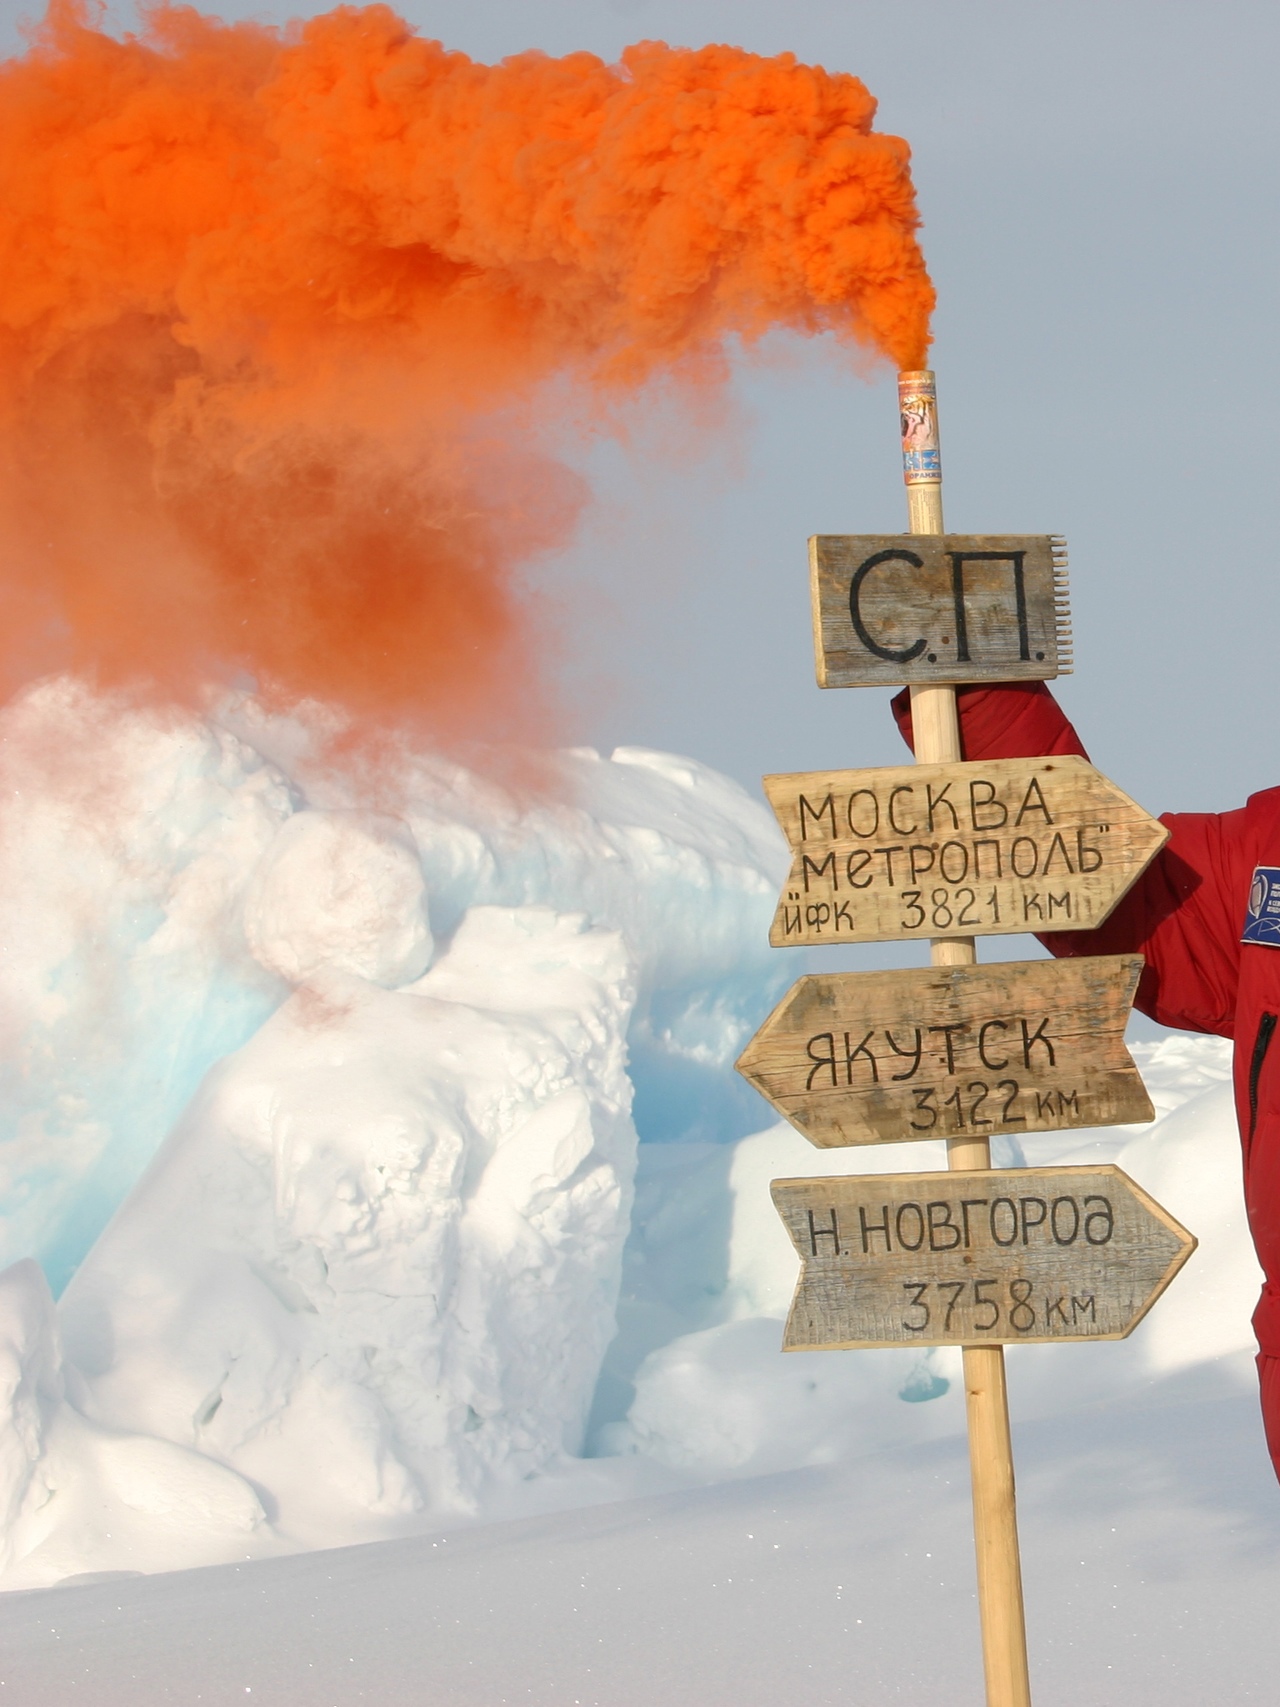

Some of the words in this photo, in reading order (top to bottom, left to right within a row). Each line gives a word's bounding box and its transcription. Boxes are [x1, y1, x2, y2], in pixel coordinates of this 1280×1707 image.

[849, 548, 1045, 663] С.П.
[799, 777, 1053, 841] МОСКВА
[901, 885, 1000, 929] 3821
[806, 1017, 1056, 1090] ЯКУТСК
[910, 1079, 1026, 1131] 3122
[902, 1279, 1035, 1332] 3758
